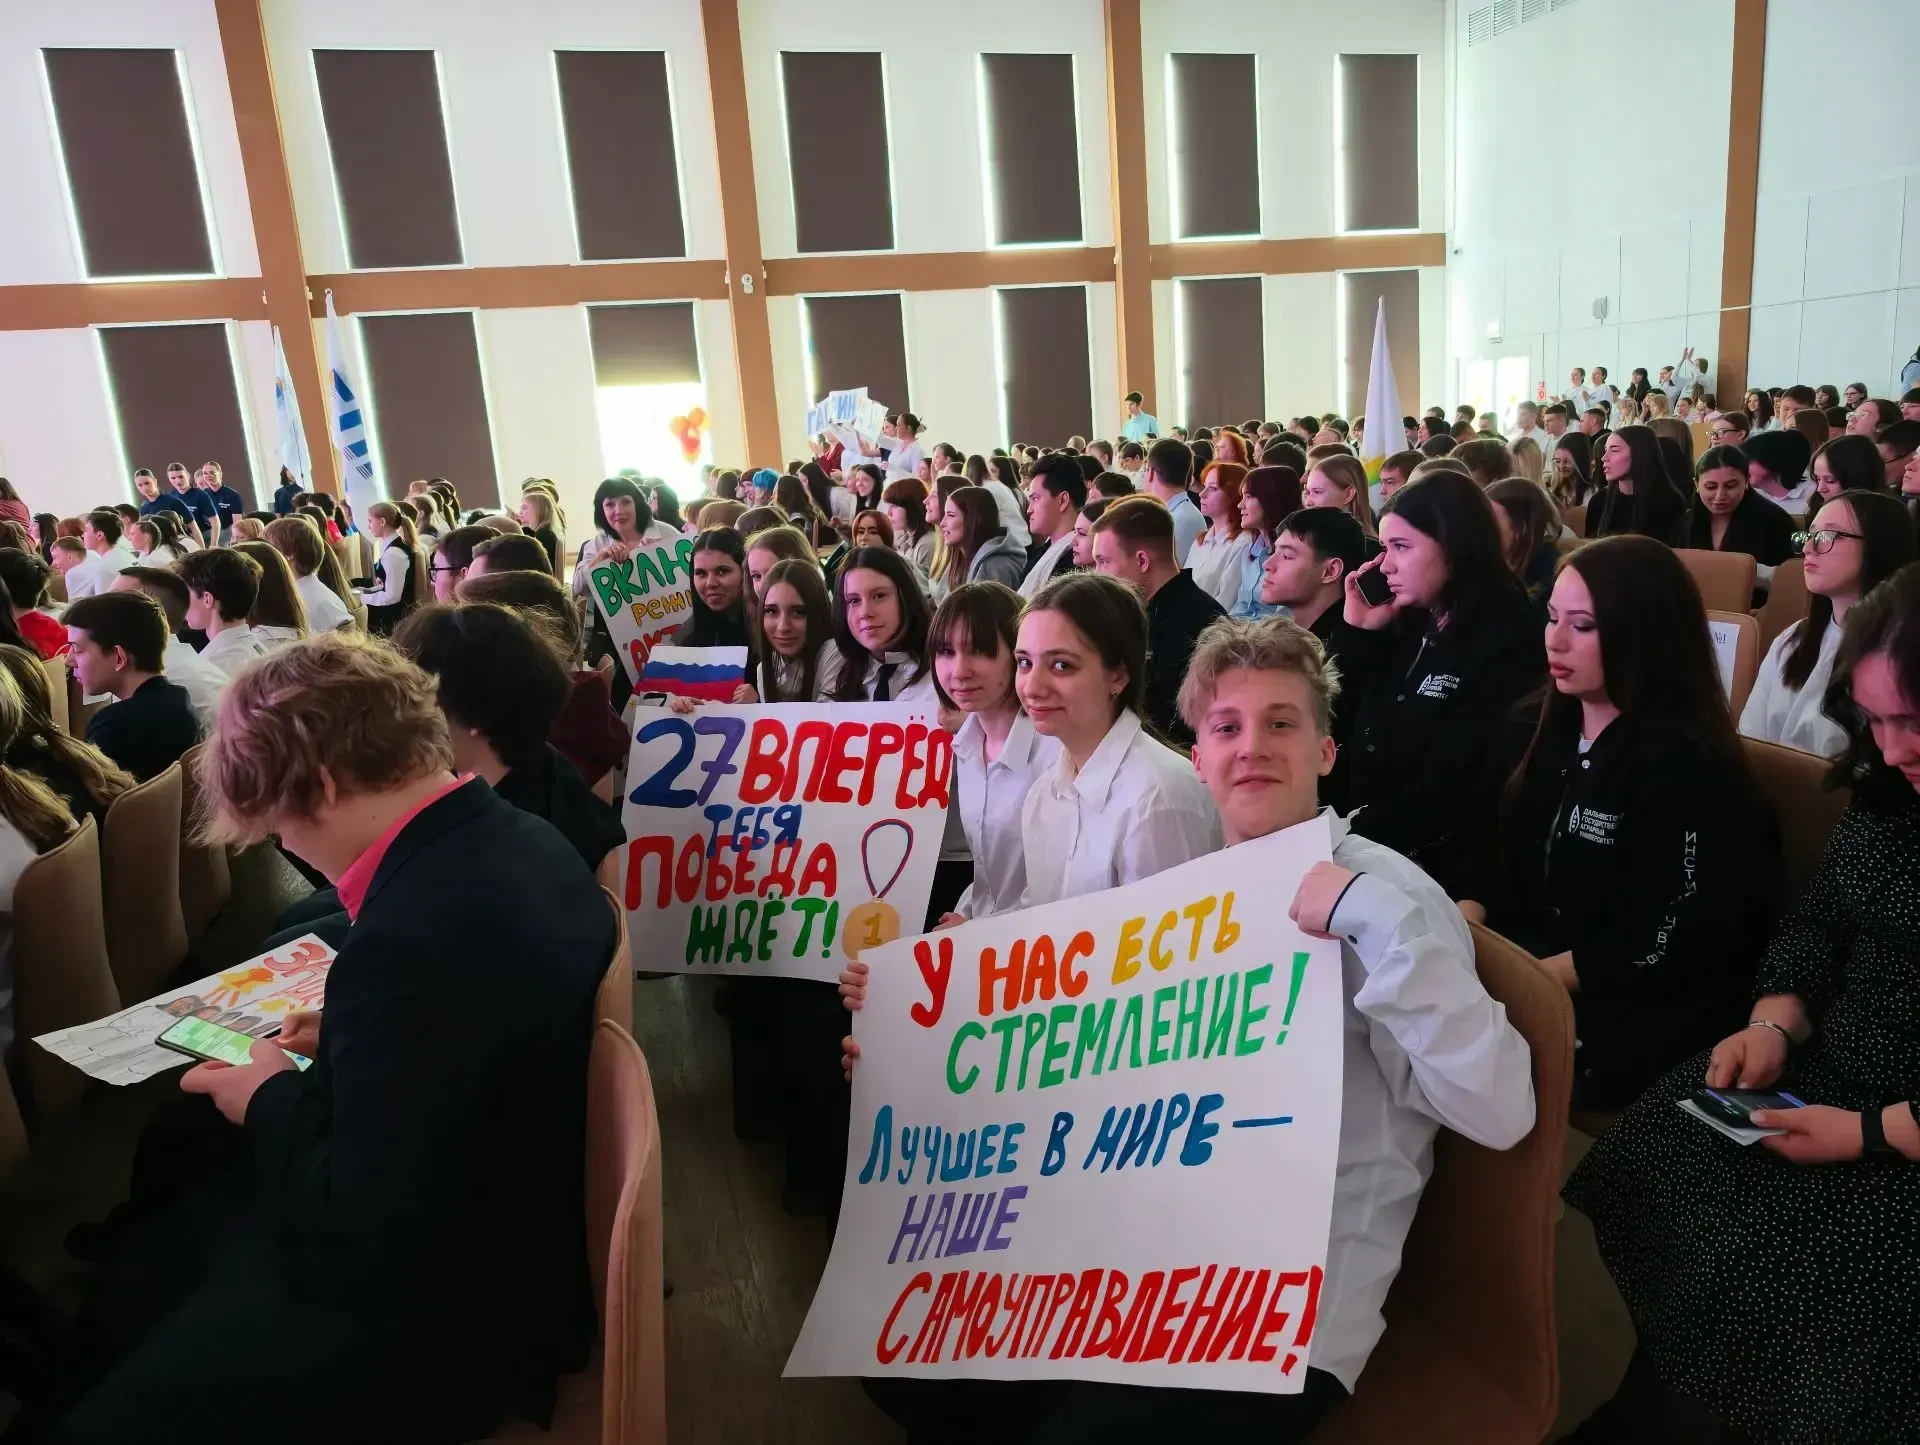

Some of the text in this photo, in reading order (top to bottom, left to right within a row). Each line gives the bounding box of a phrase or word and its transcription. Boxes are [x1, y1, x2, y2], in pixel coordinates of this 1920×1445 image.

[591, 536, 700, 617] ВКЛЮ
[629, 715, 950, 809] 27 ВПЕРЁД
[703, 804, 803, 859] ТЕБЯ
[625, 833, 838, 911] ПОБЕДА
[685, 893, 840, 966] ЖДЁТ!
[862, 913, 883, 945] 1
[911, 891, 1242, 1028] У НАС ЕСТЬ
[1040, 1111, 1074, 1176] В
[888, 1186, 1028, 1264] НАШЕ
[876, 1264, 1323, 1375] САМОУПРАВЛЕНИЕ!
